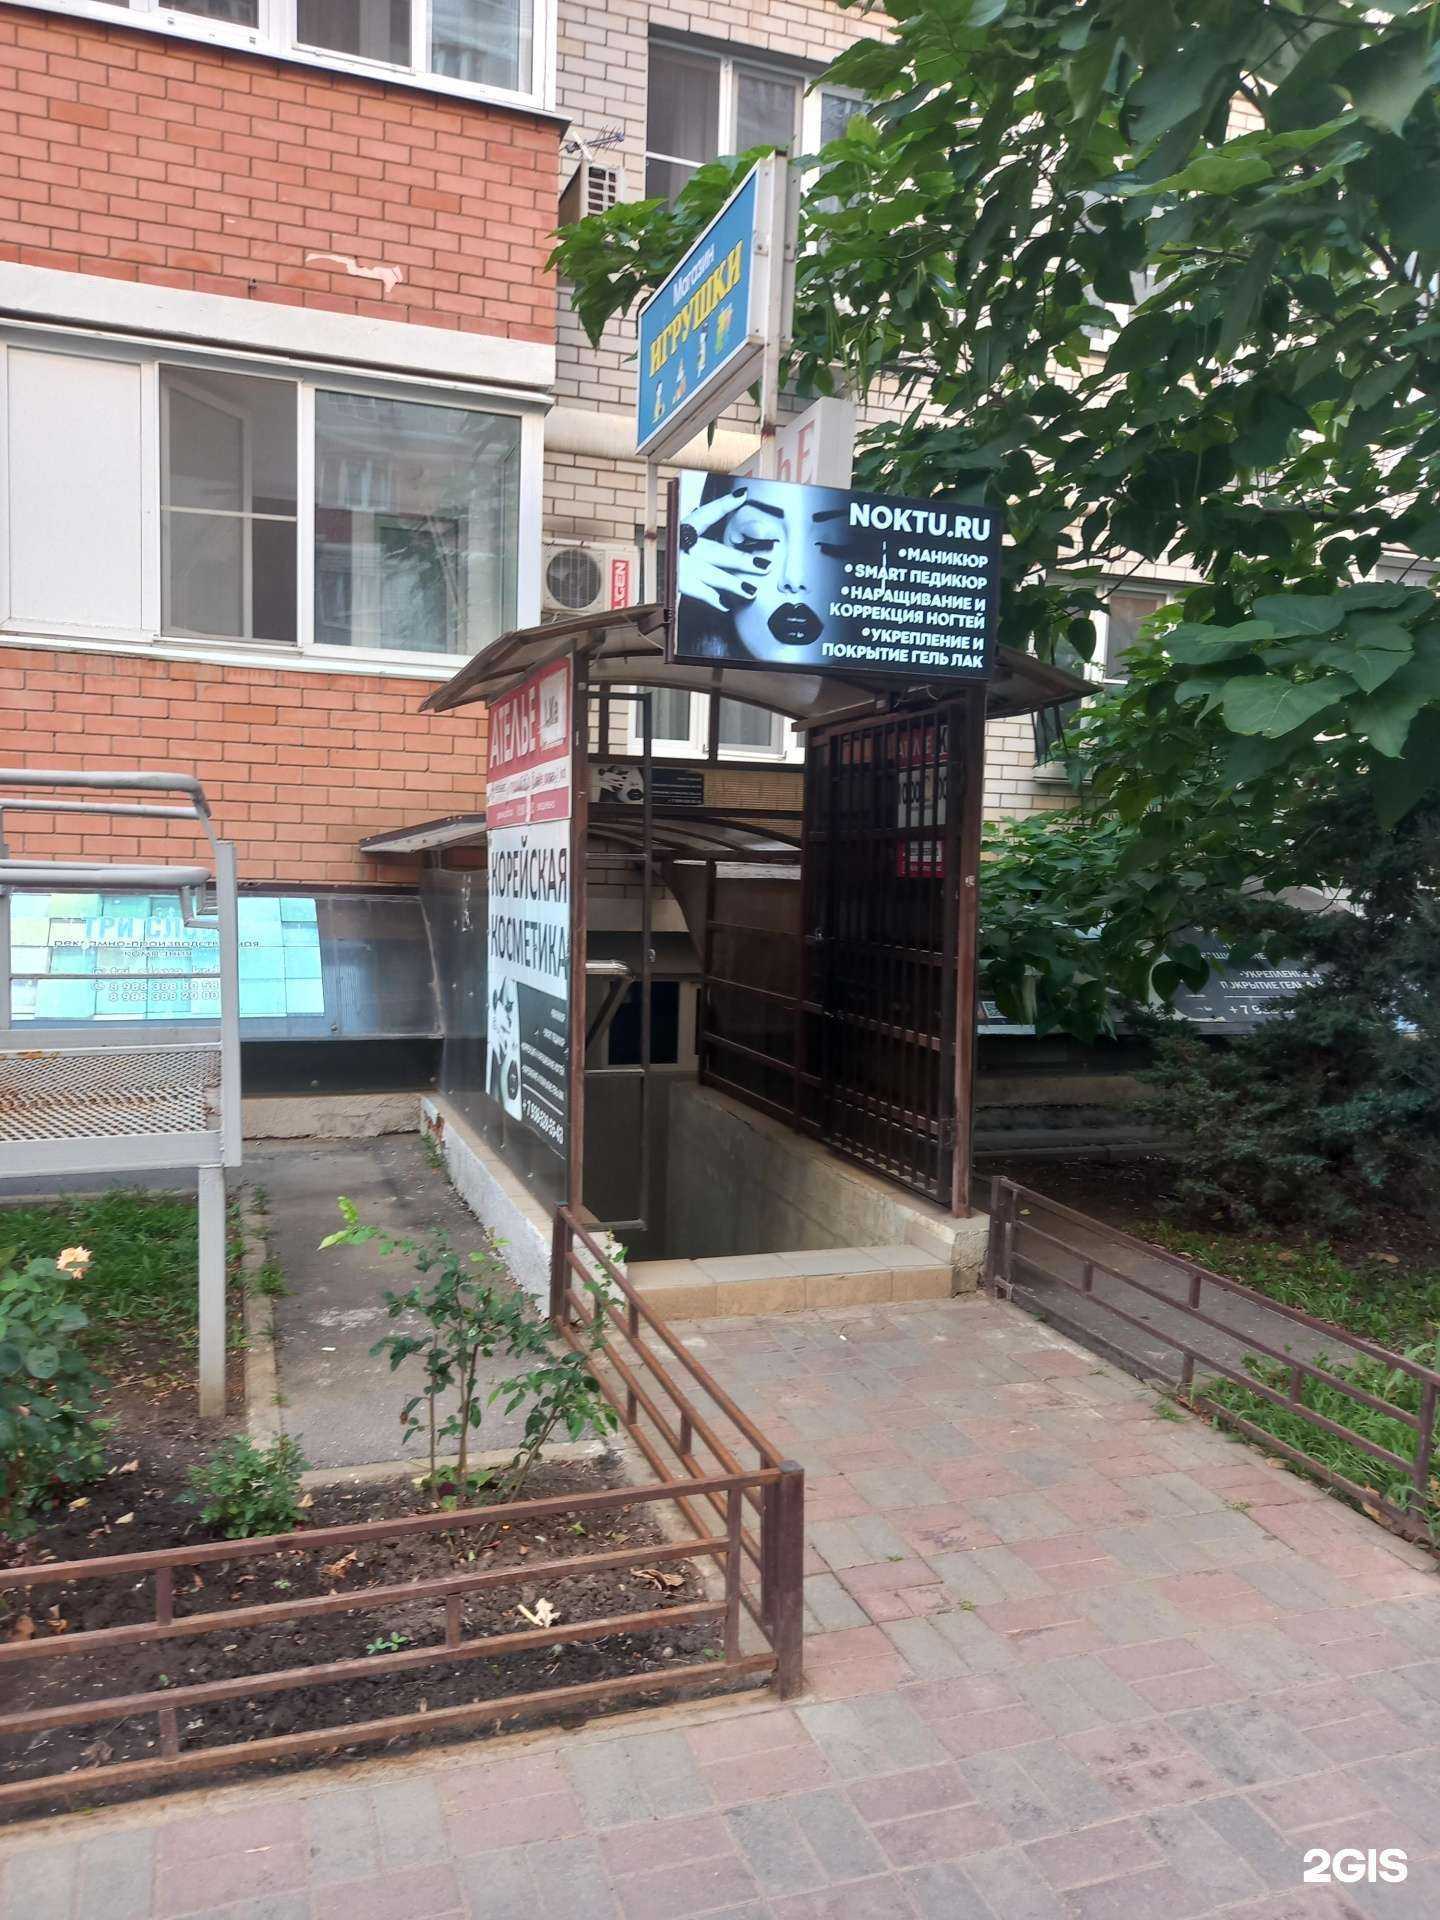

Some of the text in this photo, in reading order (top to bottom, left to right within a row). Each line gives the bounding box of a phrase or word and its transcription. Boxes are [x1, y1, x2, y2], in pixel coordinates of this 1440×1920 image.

[673, 244, 714, 306] Магазин
[649, 240, 743, 378] ИГРУШКИ
[849, 502, 991, 541] NOKTU.RU
[907, 547, 989, 569] МАНИКЮР
[855, 563, 988, 590] SMART ПЕДИКЮР
[850, 585, 986, 612] НАРАЩИВАНИЕ И
[829, 602, 985, 630] КОРРЕКЦИЯ НОГТЕЙ
[871, 627, 985, 651] УКРЕПЛЕНИЕ И
[821, 642, 984, 669] ПОКРЫТИЕ ГЕЛЬ ЛАК
[490, 686, 536, 769] АТЕЛЬЕ
[491, 835, 567, 903] КОРЕЙСКАЯ
[84, 917, 133, 938] ТРИ
[491, 914, 568, 980] КОСМЕТИКА
